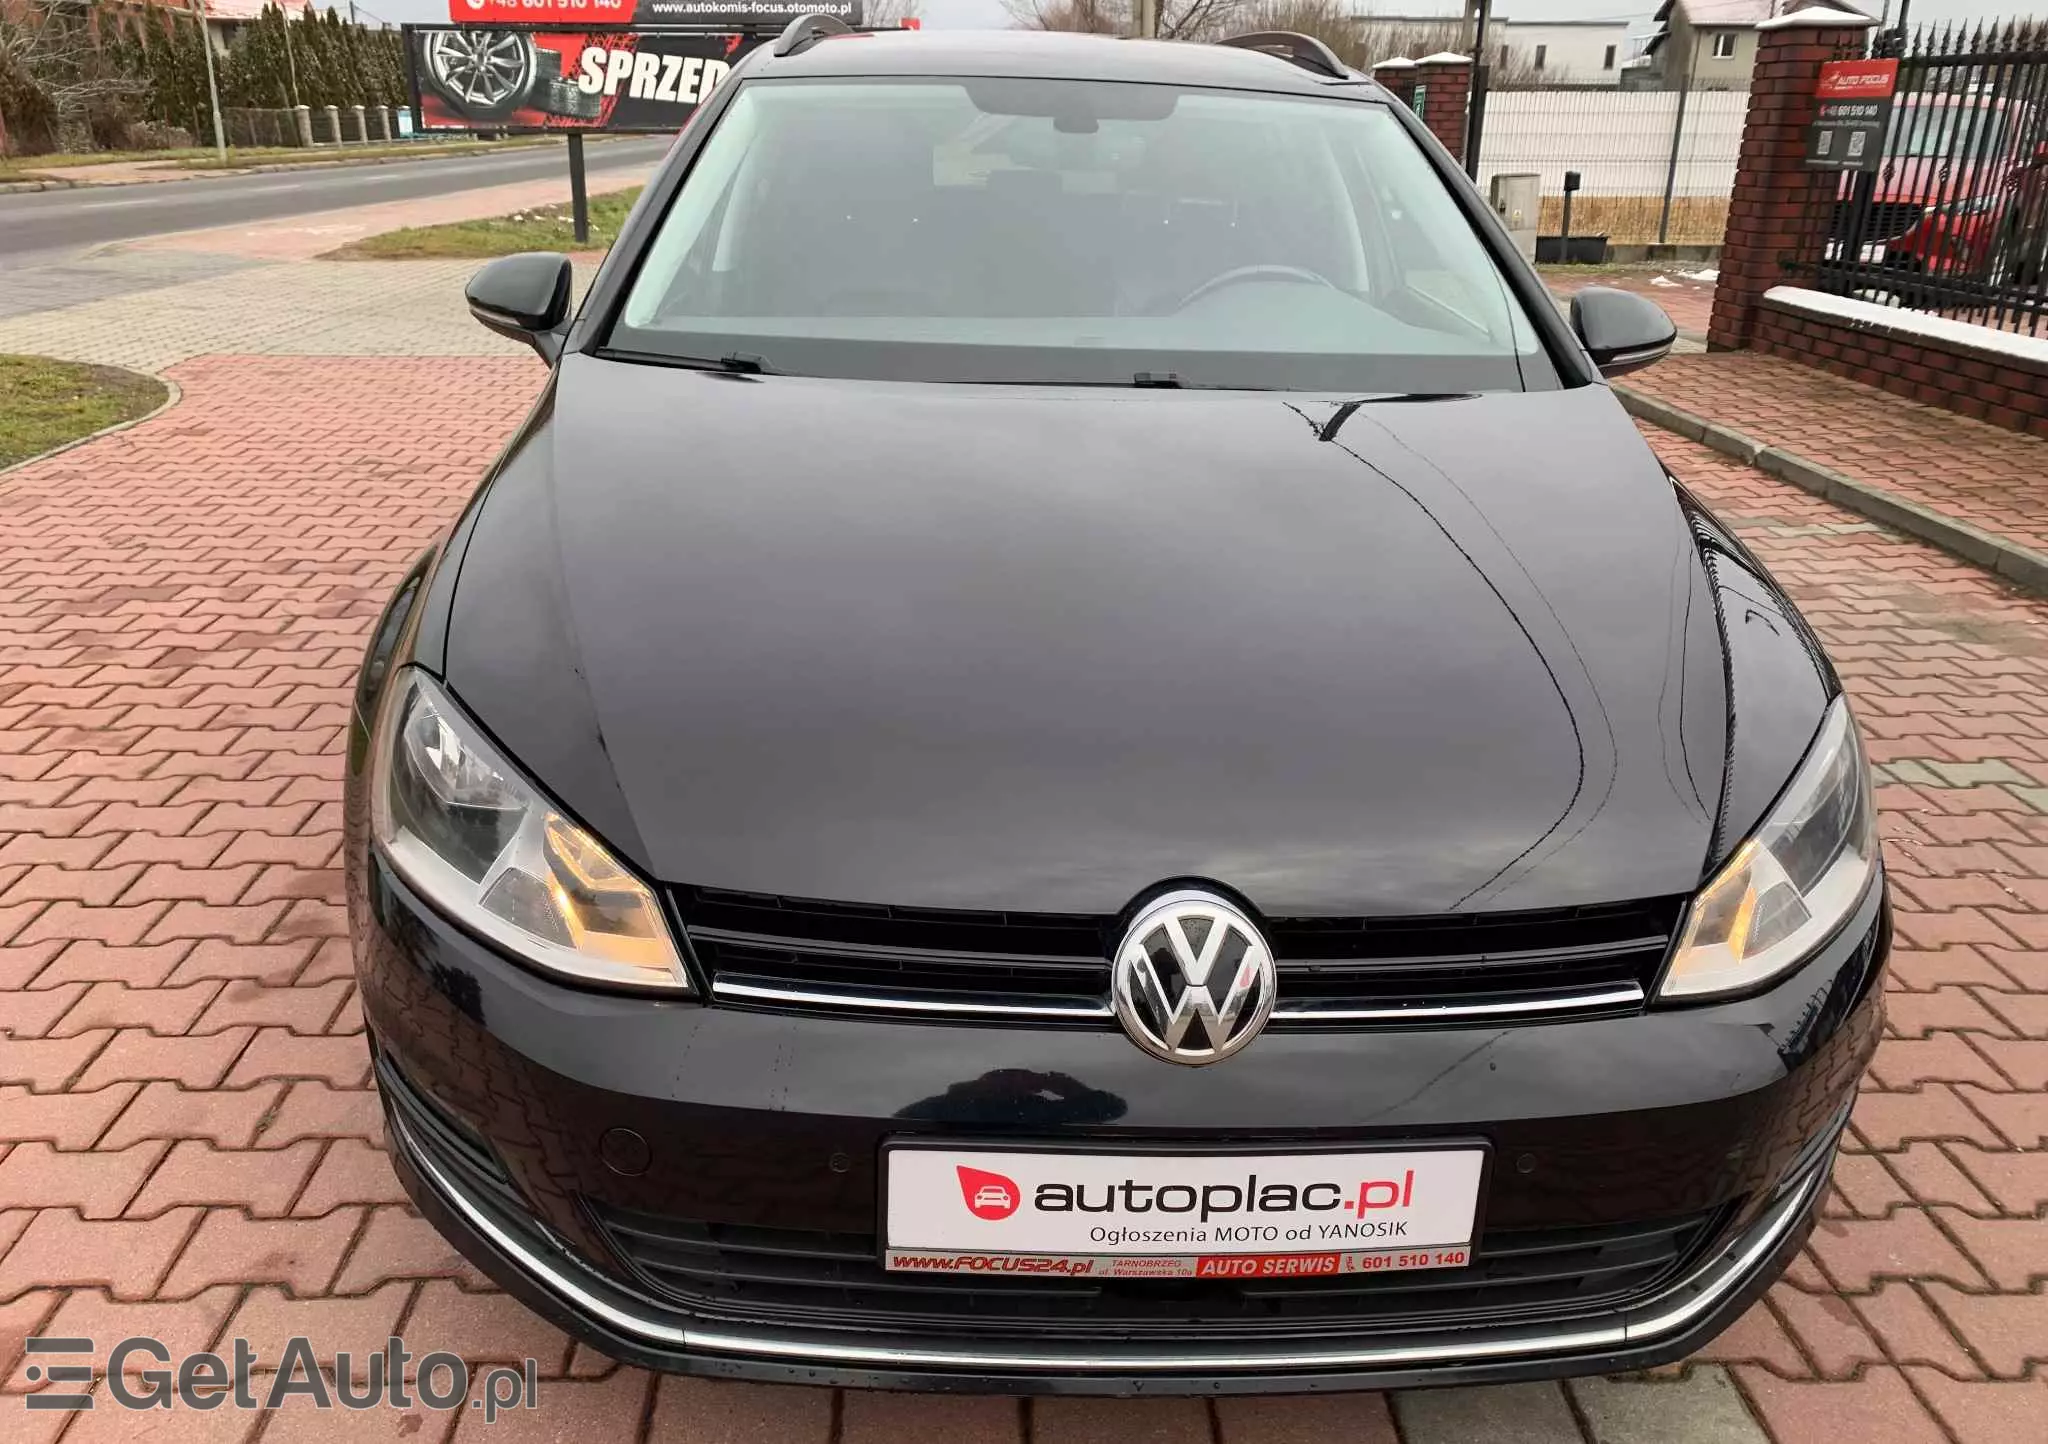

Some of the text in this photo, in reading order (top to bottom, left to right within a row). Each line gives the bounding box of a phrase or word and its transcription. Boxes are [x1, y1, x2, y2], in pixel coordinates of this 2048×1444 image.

[652, 2, 852, 16] www.autokomis-focus.otomoto.pl
[1034, 1169, 1414, 1223] autoplac.pl
[1089, 1220, 1408, 1246] Ogłoszenia MOTO od YANOSIK
[893, 1255, 1094, 1276] www.FOCUS24.pl
[1201, 1255, 1335, 1276] AUTO SERWIS
[1362, 1251, 1465, 1269] 601 510 140
